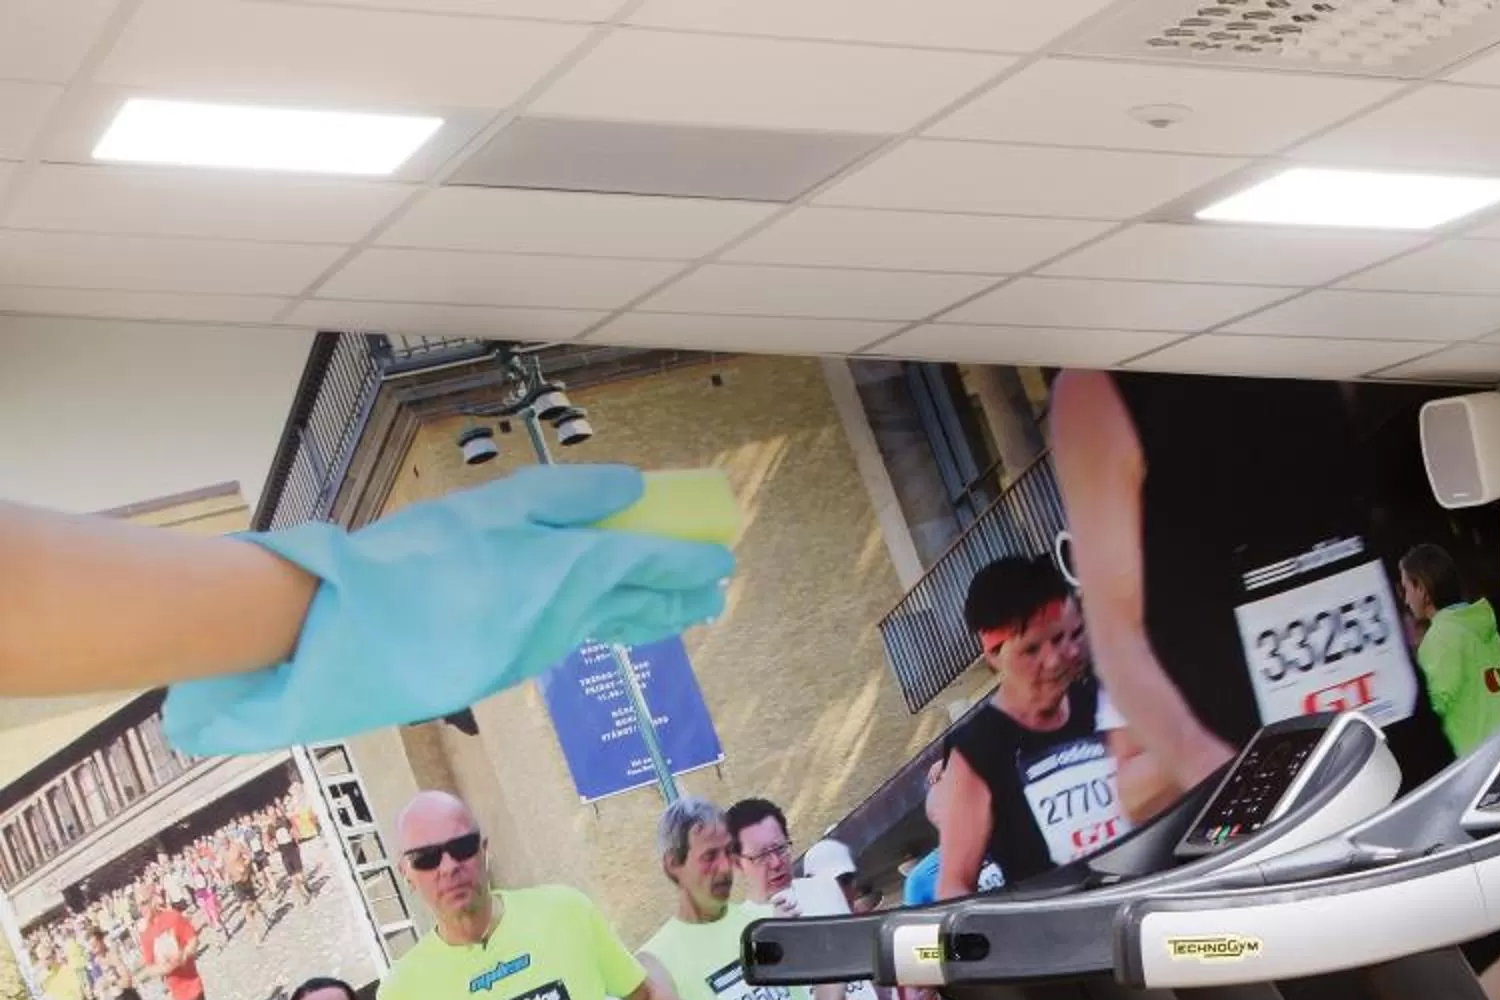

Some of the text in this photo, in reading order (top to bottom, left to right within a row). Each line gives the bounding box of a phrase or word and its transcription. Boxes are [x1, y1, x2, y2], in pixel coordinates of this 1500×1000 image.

[1257, 595, 1389, 683] 33253
[1303, 671, 1377, 713] GT
[1039, 771, 1118, 826] 2770
[1072, 816, 1121, 847] GT
[1167, 937, 1259, 958] TECHNOGYM
